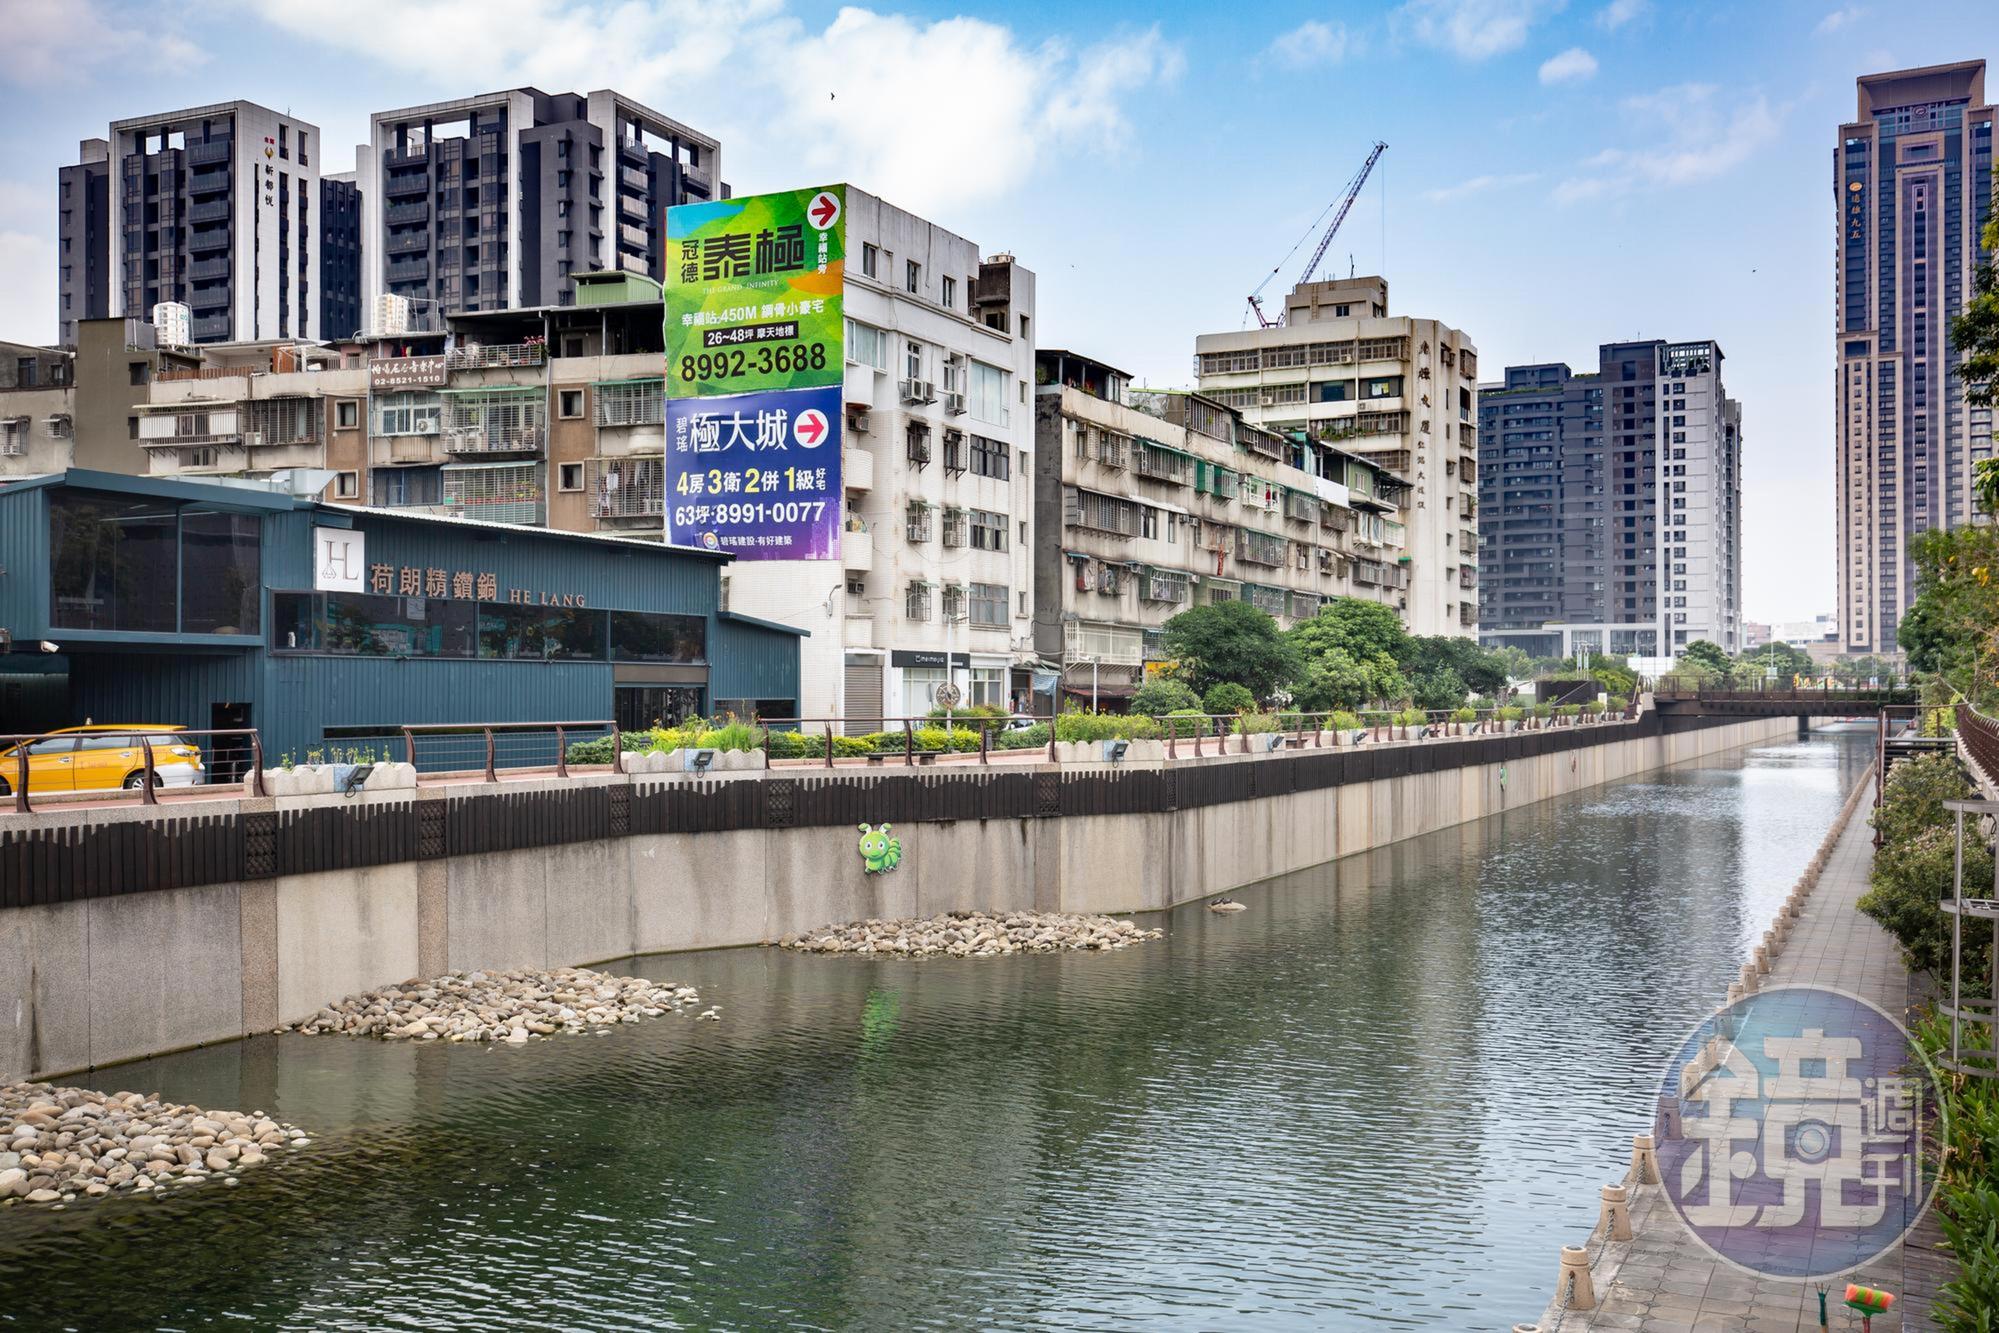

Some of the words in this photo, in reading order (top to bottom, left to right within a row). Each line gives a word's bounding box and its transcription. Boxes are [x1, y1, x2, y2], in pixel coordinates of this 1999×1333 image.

[681, 240, 699, 284] 冠德
[718, 283, 743, 293] GRAND
[747, 279, 779, 289] INFINITY
[681, 342, 826, 382] 8992-3688
[690, 409, 788, 453] 極大城
[370, 563, 497, 601] 荷朗精鑽鍋
[510, 589, 531, 604] HE
[540, 592, 585, 607] LANG
